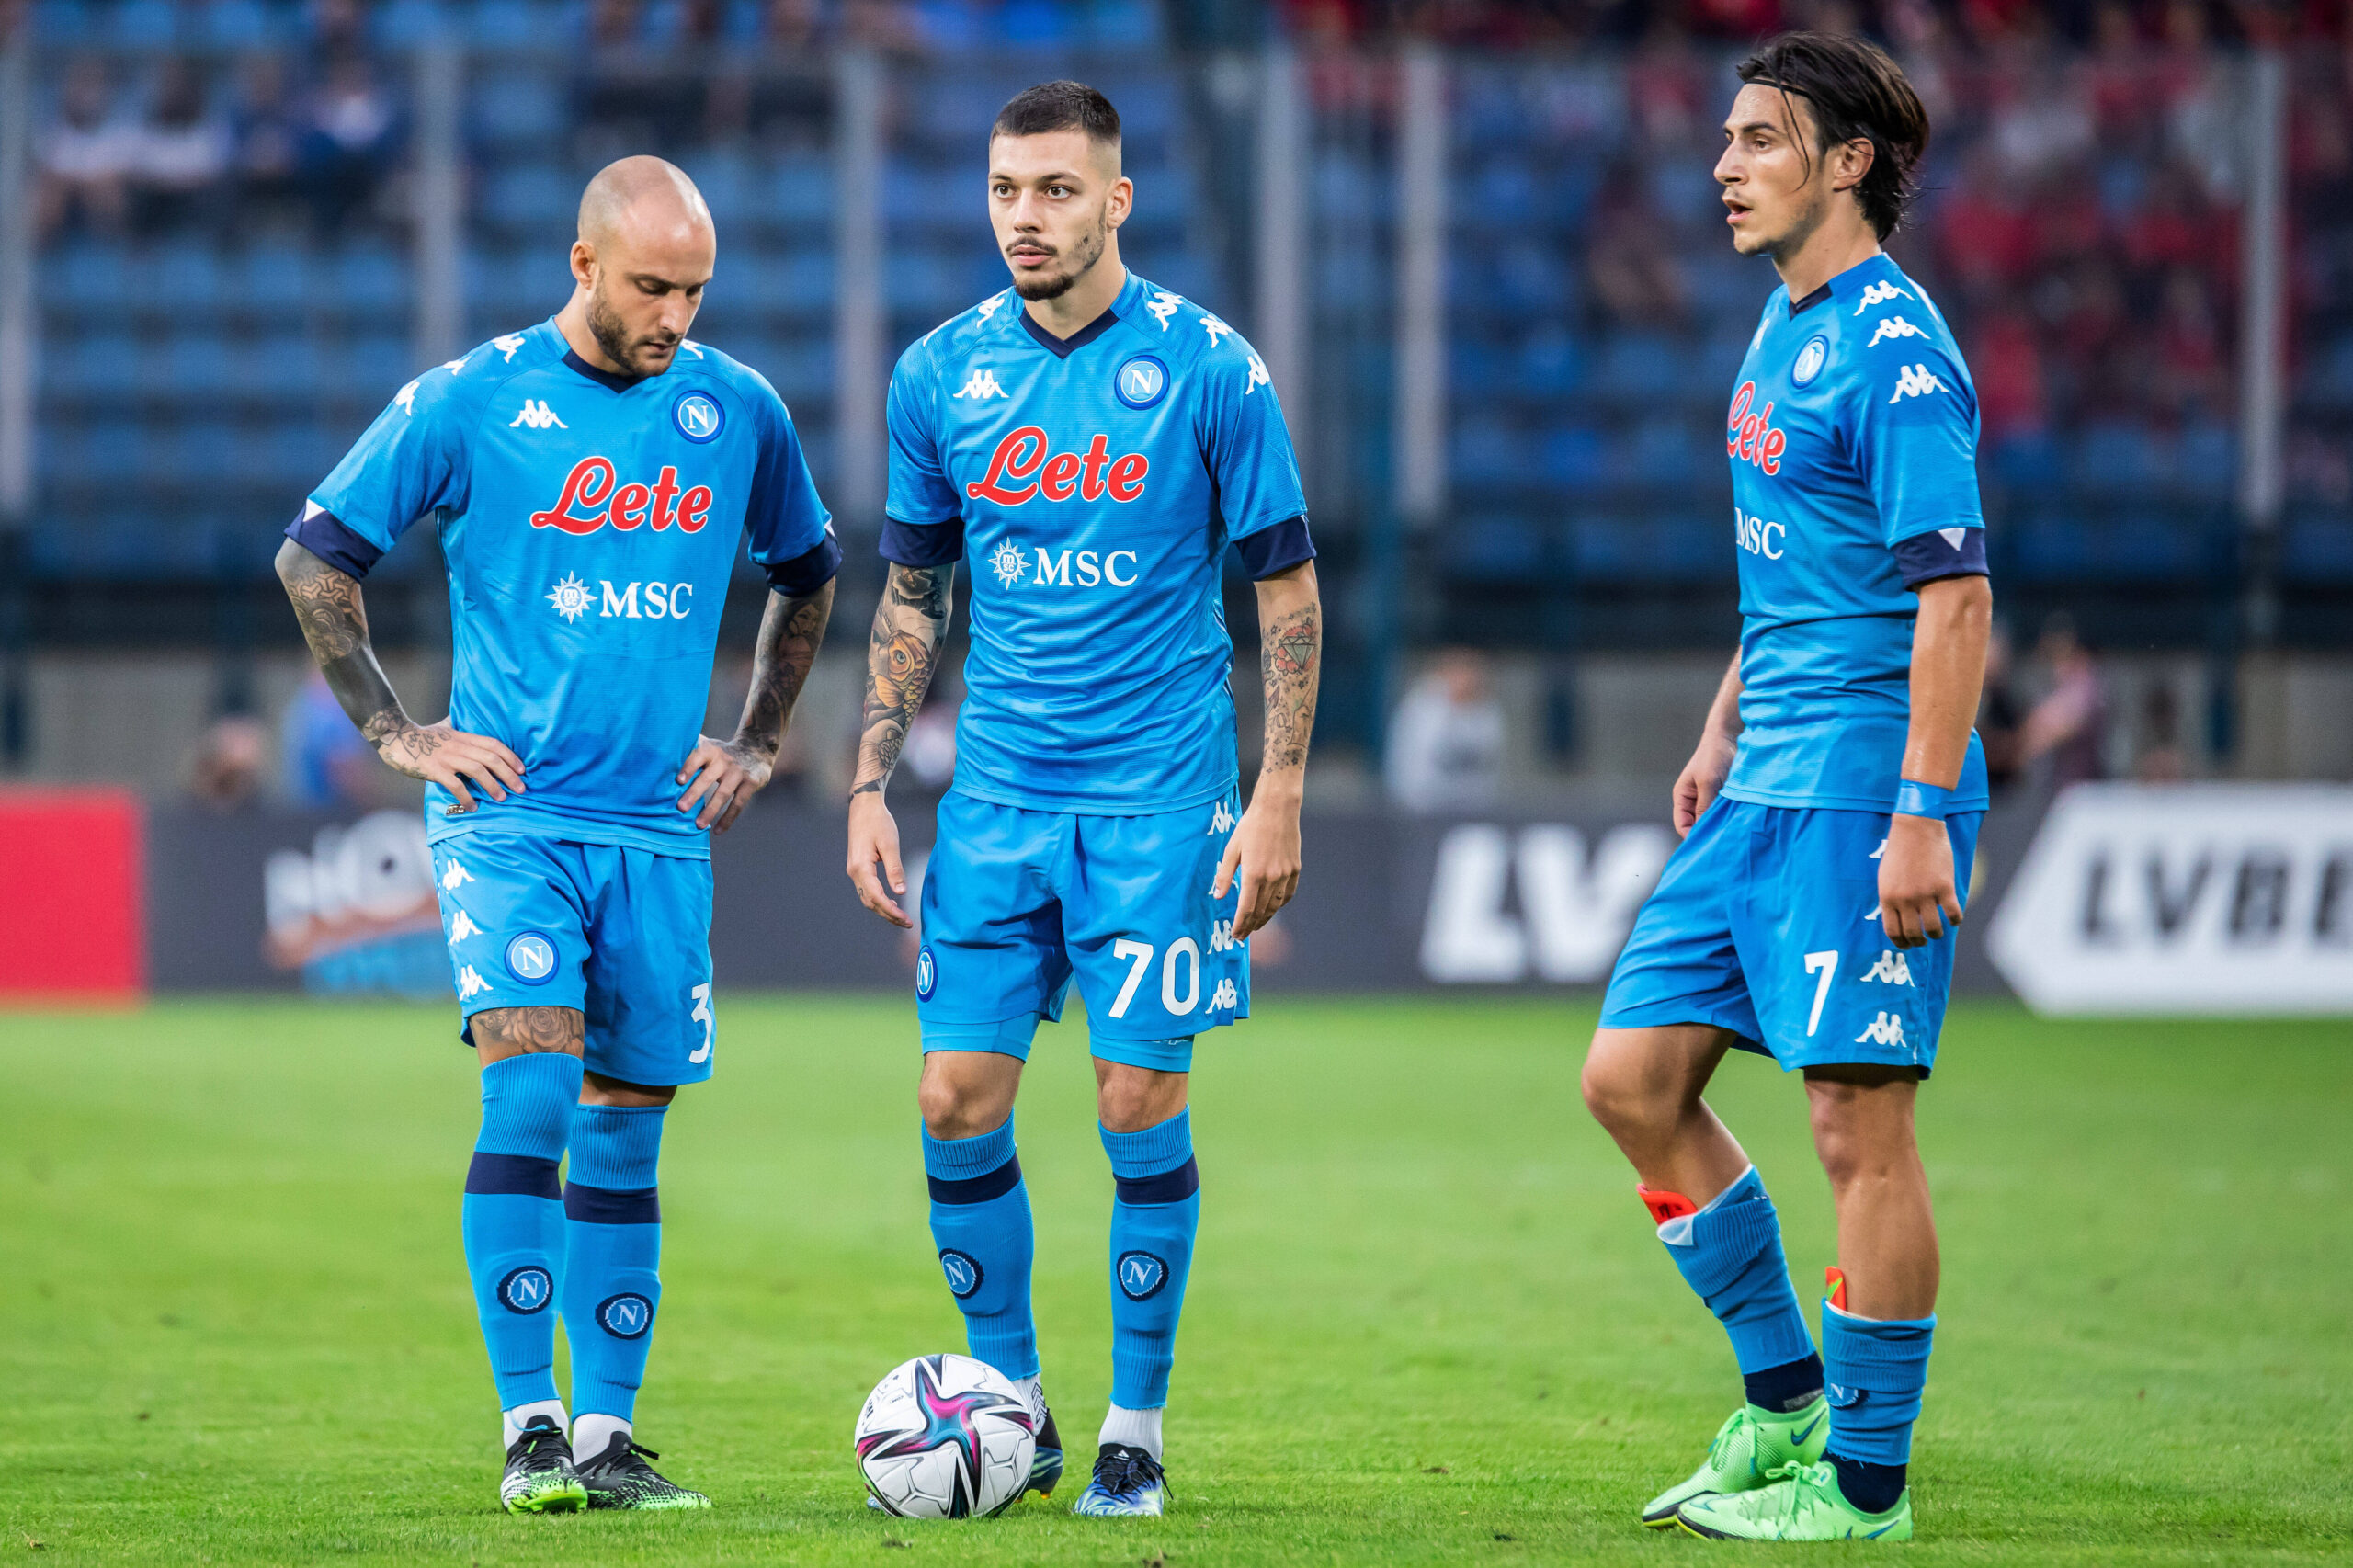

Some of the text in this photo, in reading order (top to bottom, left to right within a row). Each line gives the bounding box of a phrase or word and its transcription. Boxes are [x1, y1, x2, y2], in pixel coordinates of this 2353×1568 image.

[1129, 369, 1155, 394] N
[686, 404, 709, 429] N
[1727, 380, 1786, 476] Lete
[966, 426, 1149, 506] Lete
[529, 456, 713, 535] Lete
[1734, 507, 1786, 561] MSC
[1032, 547, 1138, 587] MSC
[599, 580, 693, 619] MSC
[519, 945, 544, 971] N
[919, 960, 930, 987] N
[1108, 937, 1200, 1019] 70
[1804, 949, 1839, 1038] 7
[688, 982, 712, 1064] 3
[518, 1278, 540, 1301] N
[945, 1261, 967, 1286] N
[1126, 1263, 1154, 1287] N
[616, 1304, 640, 1326] N
